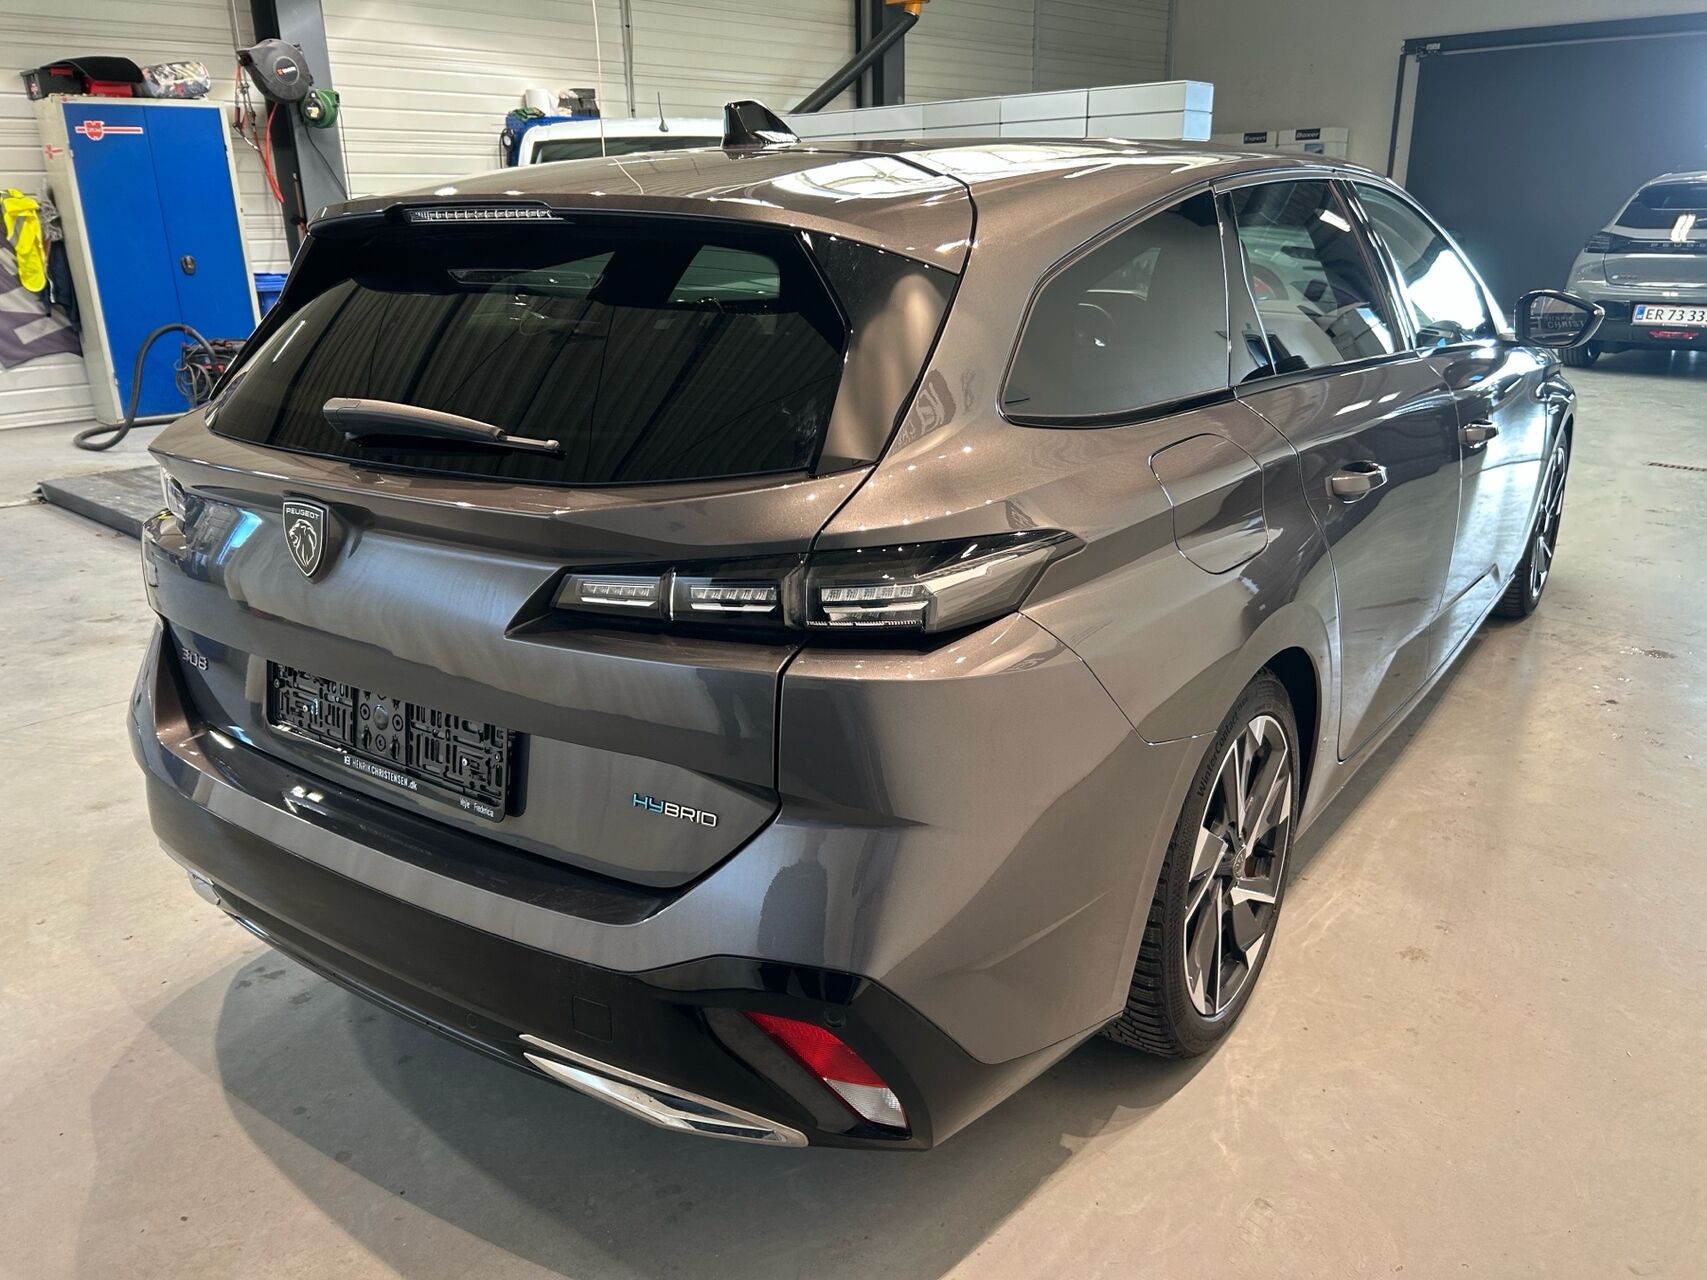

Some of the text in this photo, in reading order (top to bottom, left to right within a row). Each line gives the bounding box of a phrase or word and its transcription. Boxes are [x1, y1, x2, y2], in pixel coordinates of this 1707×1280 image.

[1645, 309, 1707, 322] ER 73 33
[286, 507, 320, 519] PEUGEOT
[182, 647, 207, 671] 308
[633, 793, 717, 827] HYBRID
